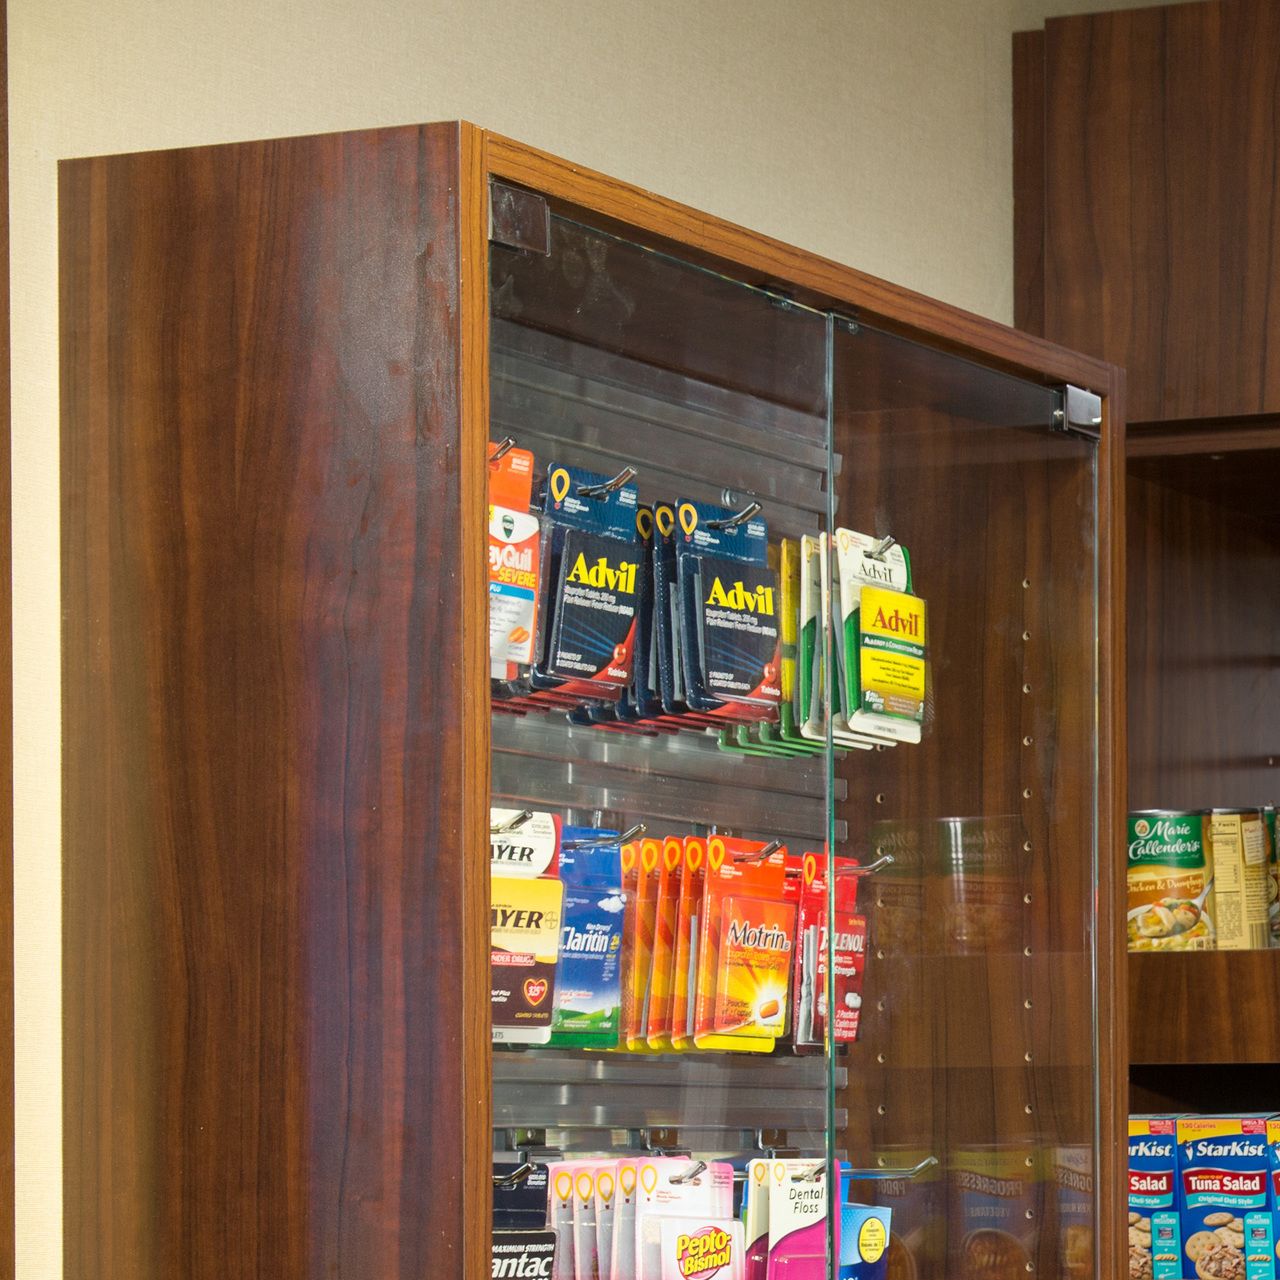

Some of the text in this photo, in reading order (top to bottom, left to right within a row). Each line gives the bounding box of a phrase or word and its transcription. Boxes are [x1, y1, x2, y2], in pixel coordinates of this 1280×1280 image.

[498, 566, 536, 587] SEVERE
[566, 552, 636, 594] Advil
[859, 563, 894, 583] Advil
[705, 577, 774, 615] Advil
[872, 607, 920, 637] Advil
[1153, 820, 1192, 841] Marie
[1129, 836, 1201, 860] Callender's
[559, 926, 608, 952] Claritin
[726, 920, 785, 950] Motrin
[1196, 1141, 1264, 1156] StarKist
[789, 1187, 824, 1201] Dental
[1131, 1176, 1167, 1190] Salad
[1189, 1176, 1260, 1190] Tuna Salad
[794, 1202, 818, 1214] Floss
[526, 1244, 554, 1252] STRENGTH
[677, 1230, 732, 1260] Pepto-
[492, 1253, 553, 1278] antac
[683, 1247, 731, 1277] Bismol
